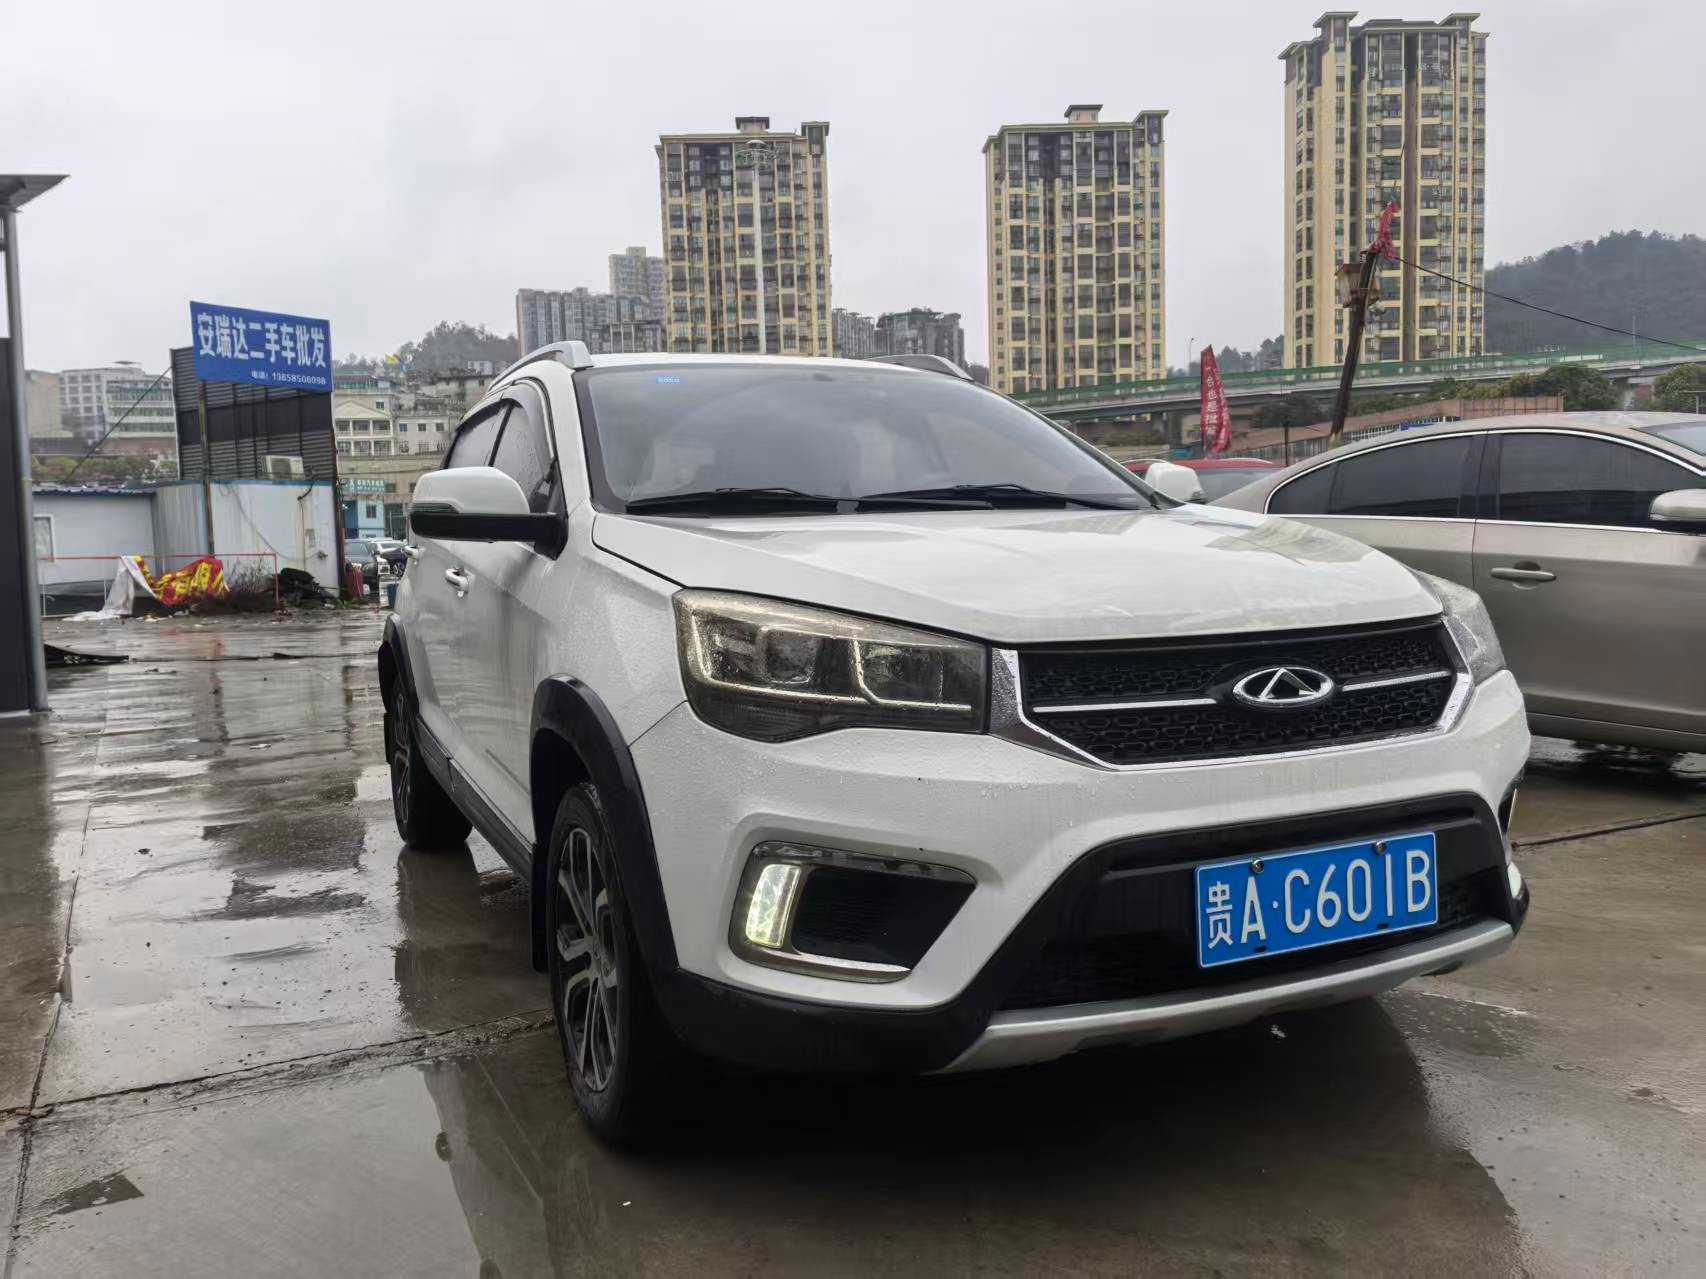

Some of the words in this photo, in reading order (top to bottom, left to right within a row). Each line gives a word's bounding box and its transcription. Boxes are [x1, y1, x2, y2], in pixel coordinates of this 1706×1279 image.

[197, 312, 327, 368] 安瑞达二手车批发
